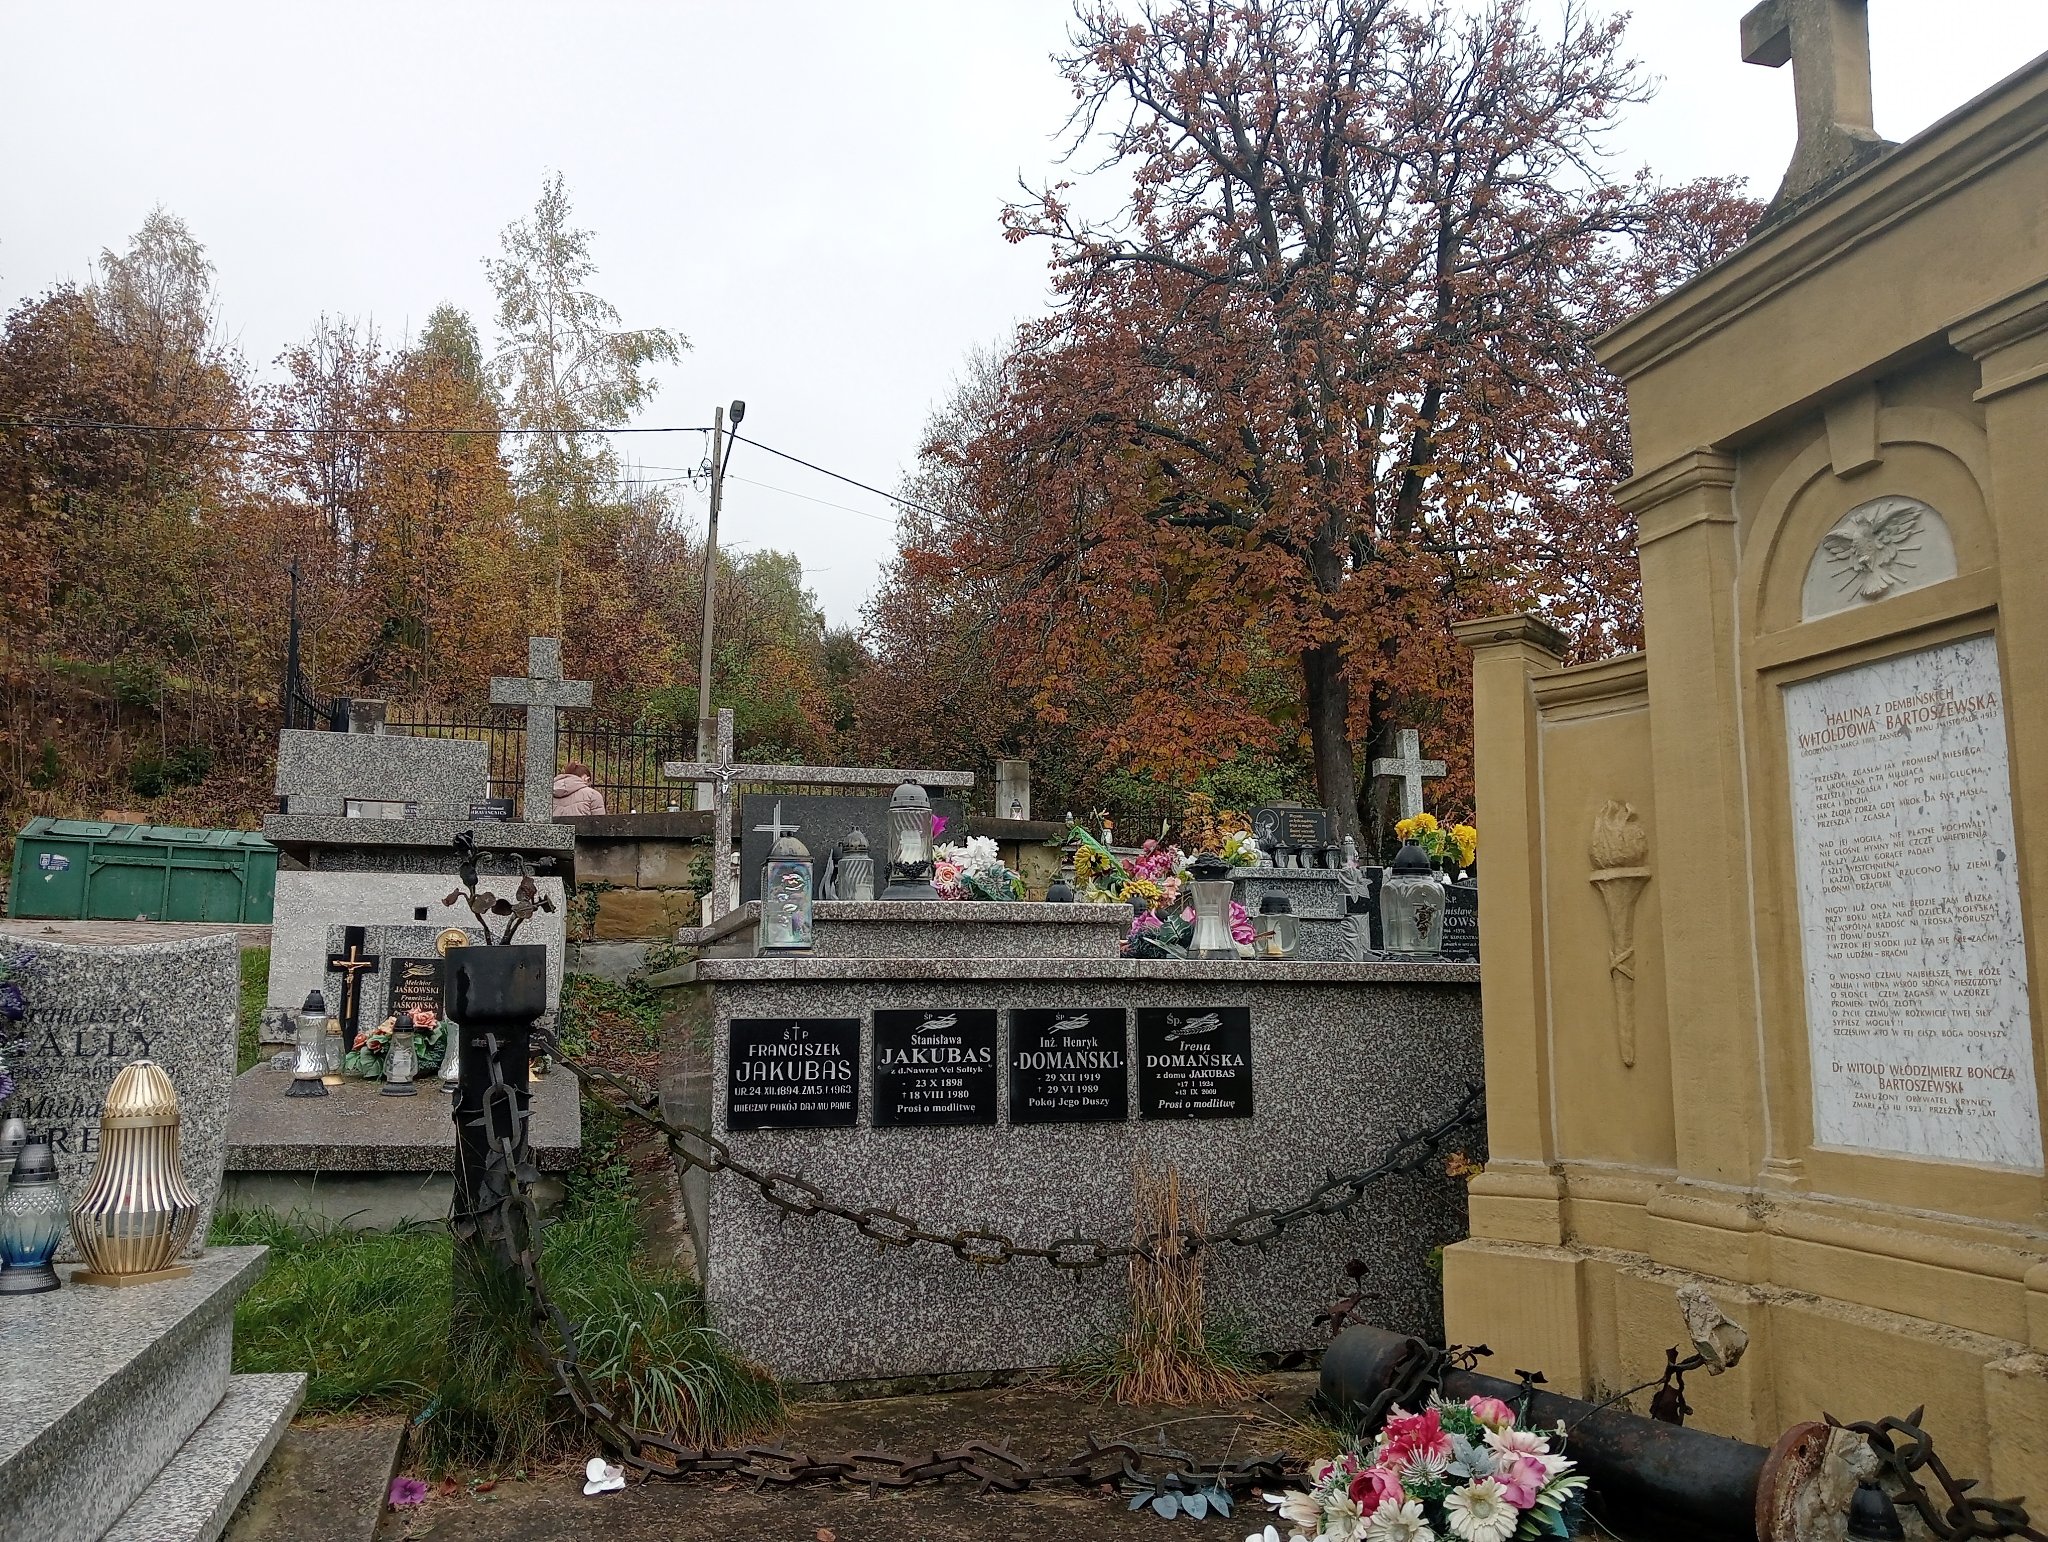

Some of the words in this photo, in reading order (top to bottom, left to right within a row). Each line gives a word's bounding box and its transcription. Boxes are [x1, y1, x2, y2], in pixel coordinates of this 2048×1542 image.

[1827, 705, 1871, 726] HALINA
[1876, 704, 1880, 715] Z
[1885, 686, 1954, 712] DEMBIŃSKICH
[1799, 720, 1876, 748] WITOLDOWA
[1886, 692, 1997, 729] BARTOSZEWSKA
[1916, 724, 1933, 733] PANU
[1884, 763, 1895, 772] JAK
[1827, 779, 1864, 791] UKOCHANA
[1856, 785, 1881, 794] ZGASŁA
[1893, 780, 1908, 788] NOC
[1816, 802, 1835, 810] SERCA
[1855, 804, 1876, 814] ZORZA
[1881, 801, 1894, 810] GDY
[1900, 798, 1920, 806] MROK
[1864, 812, 1890, 822] ZGASŁA
[1819, 841, 1834, 849] NAD
[1908, 827, 1934, 836] PŁATNE
[1834, 847, 1860, 856] GŁOŚNE
[1864, 843, 1889, 852] HYMNY
[1908, 847, 1934, 856] PADAŁY
[1900, 866, 1942, 876] RZUCONO
[1966, 860, 1991, 870] ZIEMI
[1826, 906, 1847, 914] NIGDY
[1910, 898, 1936, 908] BĘDZIE
[1965, 894, 1992, 902] BLIZKA
[1872, 912, 1892, 920] MĘŻA
[1876, 920, 1905, 928] RADOŚĆ
[1924, 916, 1953, 926] TROSKA
[1958, 914, 1994, 924] PORUSZY
[1840, 932, 1862, 940] DOMU
[1906, 970, 1950, 978] NAJBIELSZE
[394, 985, 438, 994] JAŚKOWSKI
[392, 1000, 438, 1009] JAŚKOWSKA
[1869, 1000, 1888, 1008] TWÓJ
[27, 1003, 152, 1025] ranciszek
[1166, 1012, 1182, 1026] Śp.
[14, 1031, 164, 1057] ALLY
[911, 1034, 962, 1046] Stanisława
[1040, 1037, 1058, 1048] Inż.
[1063, 1036, 1098, 1050] Henryk
[749, 1044, 840, 1056] FRANCISZEK
[1180, 1041, 1211, 1052] Irena
[881, 1047, 991, 1064] JAKUBAS
[1020, 1050, 1119, 1070] DOMAŃSKI
[1146, 1051, 1244, 1068] DOMAŃSKA
[736, 1060, 852, 1082] JAKUBAS
[956, 1066, 983, 1075] Sołtyk
[1188, 1070, 1236, 1078] JAKUBAS
[1832, 1062, 1842, 1072] Dr
[1847, 1063, 1884, 1074] WITOLD
[1968, 1065, 2016, 1080] BOŃCZA
[942, 1079, 963, 1087] 1898
[1045, 1074, 1056, 1082] 29
[1060, 1074, 1076, 1082] XII
[1080, 1073, 1100, 1082] 1919
[1048, 1086, 1058, 1094] 29
[1062, 1086, 1074, 1094] VI
[1078, 1085, 1098, 1094] 1989
[1880, 1078, 1962, 1094] BARTOSZEWSKI
[923, 1091, 944, 1099] VIII
[948, 1090, 969, 1098] 1980
[21, 1097, 102, 1119] Micha
[734, 1104, 768, 1112] WIECZNY
[770, 1100, 798, 1112] POKÓJ
[800, 1102, 815, 1110] DAJ
[816, 1102, 828, 1110] MU
[1028, 1098, 1056, 1108] Pokój
[1058, 1098, 1080, 1108] Jego
[1082, 1096, 1110, 1106] Duszy
[1158, 1100, 1182, 1108] Prosi
[1194, 1098, 1236, 1109] modlitwę
[1956, 1098, 1992, 1106] KRYNICY
[897, 1104, 922, 1113] Prosi
[932, 1103, 976, 1114] modlitwę
